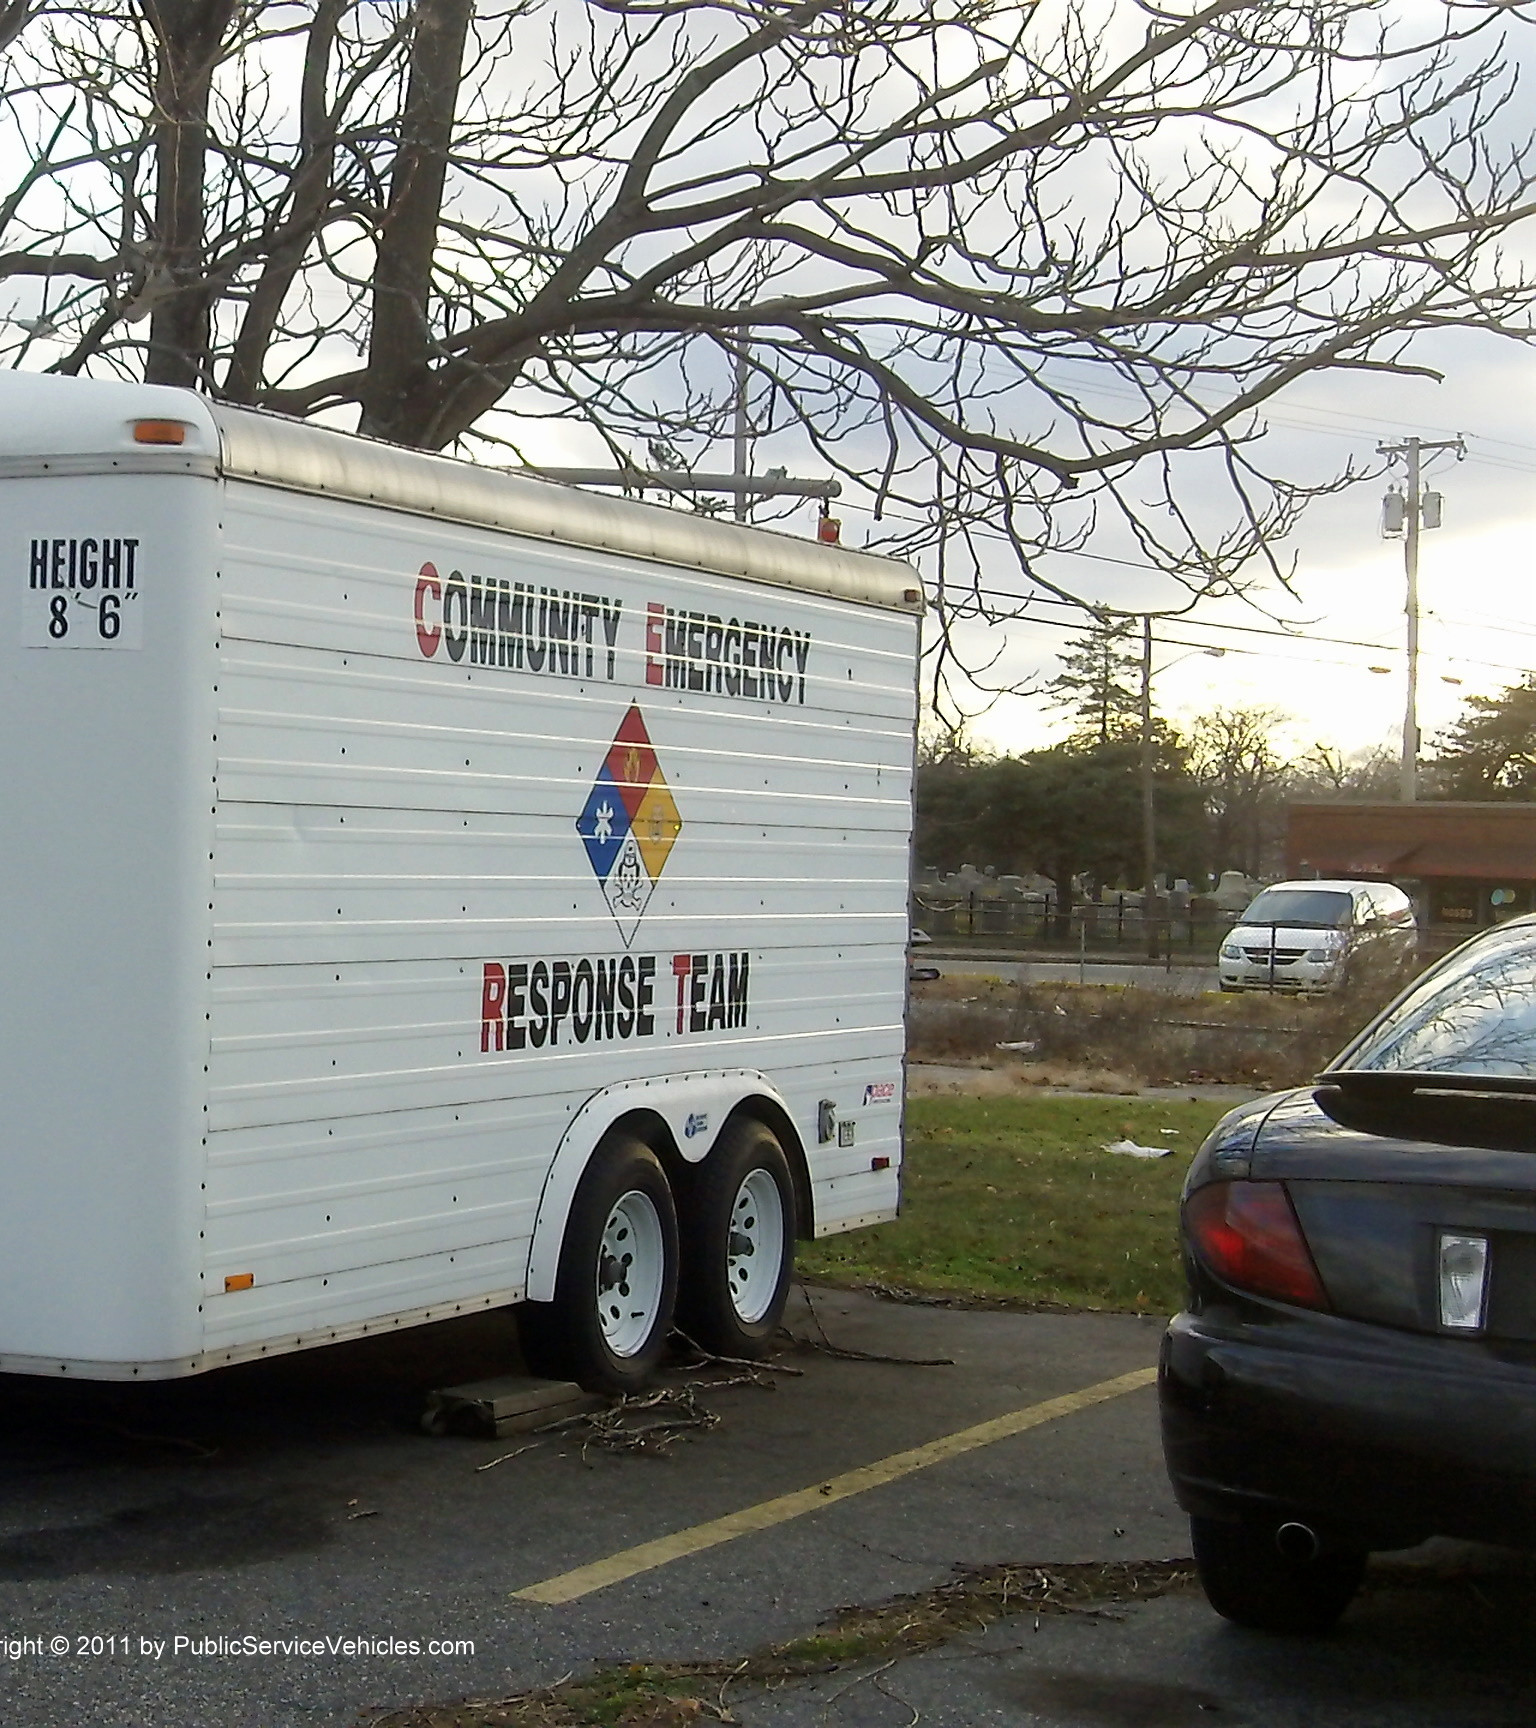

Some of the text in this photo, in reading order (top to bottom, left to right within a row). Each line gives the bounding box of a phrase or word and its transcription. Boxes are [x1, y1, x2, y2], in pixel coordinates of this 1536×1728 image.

[29, 538, 139, 589] HEIGHT
[414, 561, 811, 704] COMMUNITY EMERGENCY
[481, 952, 750, 1052] RESPONSE TEAM
